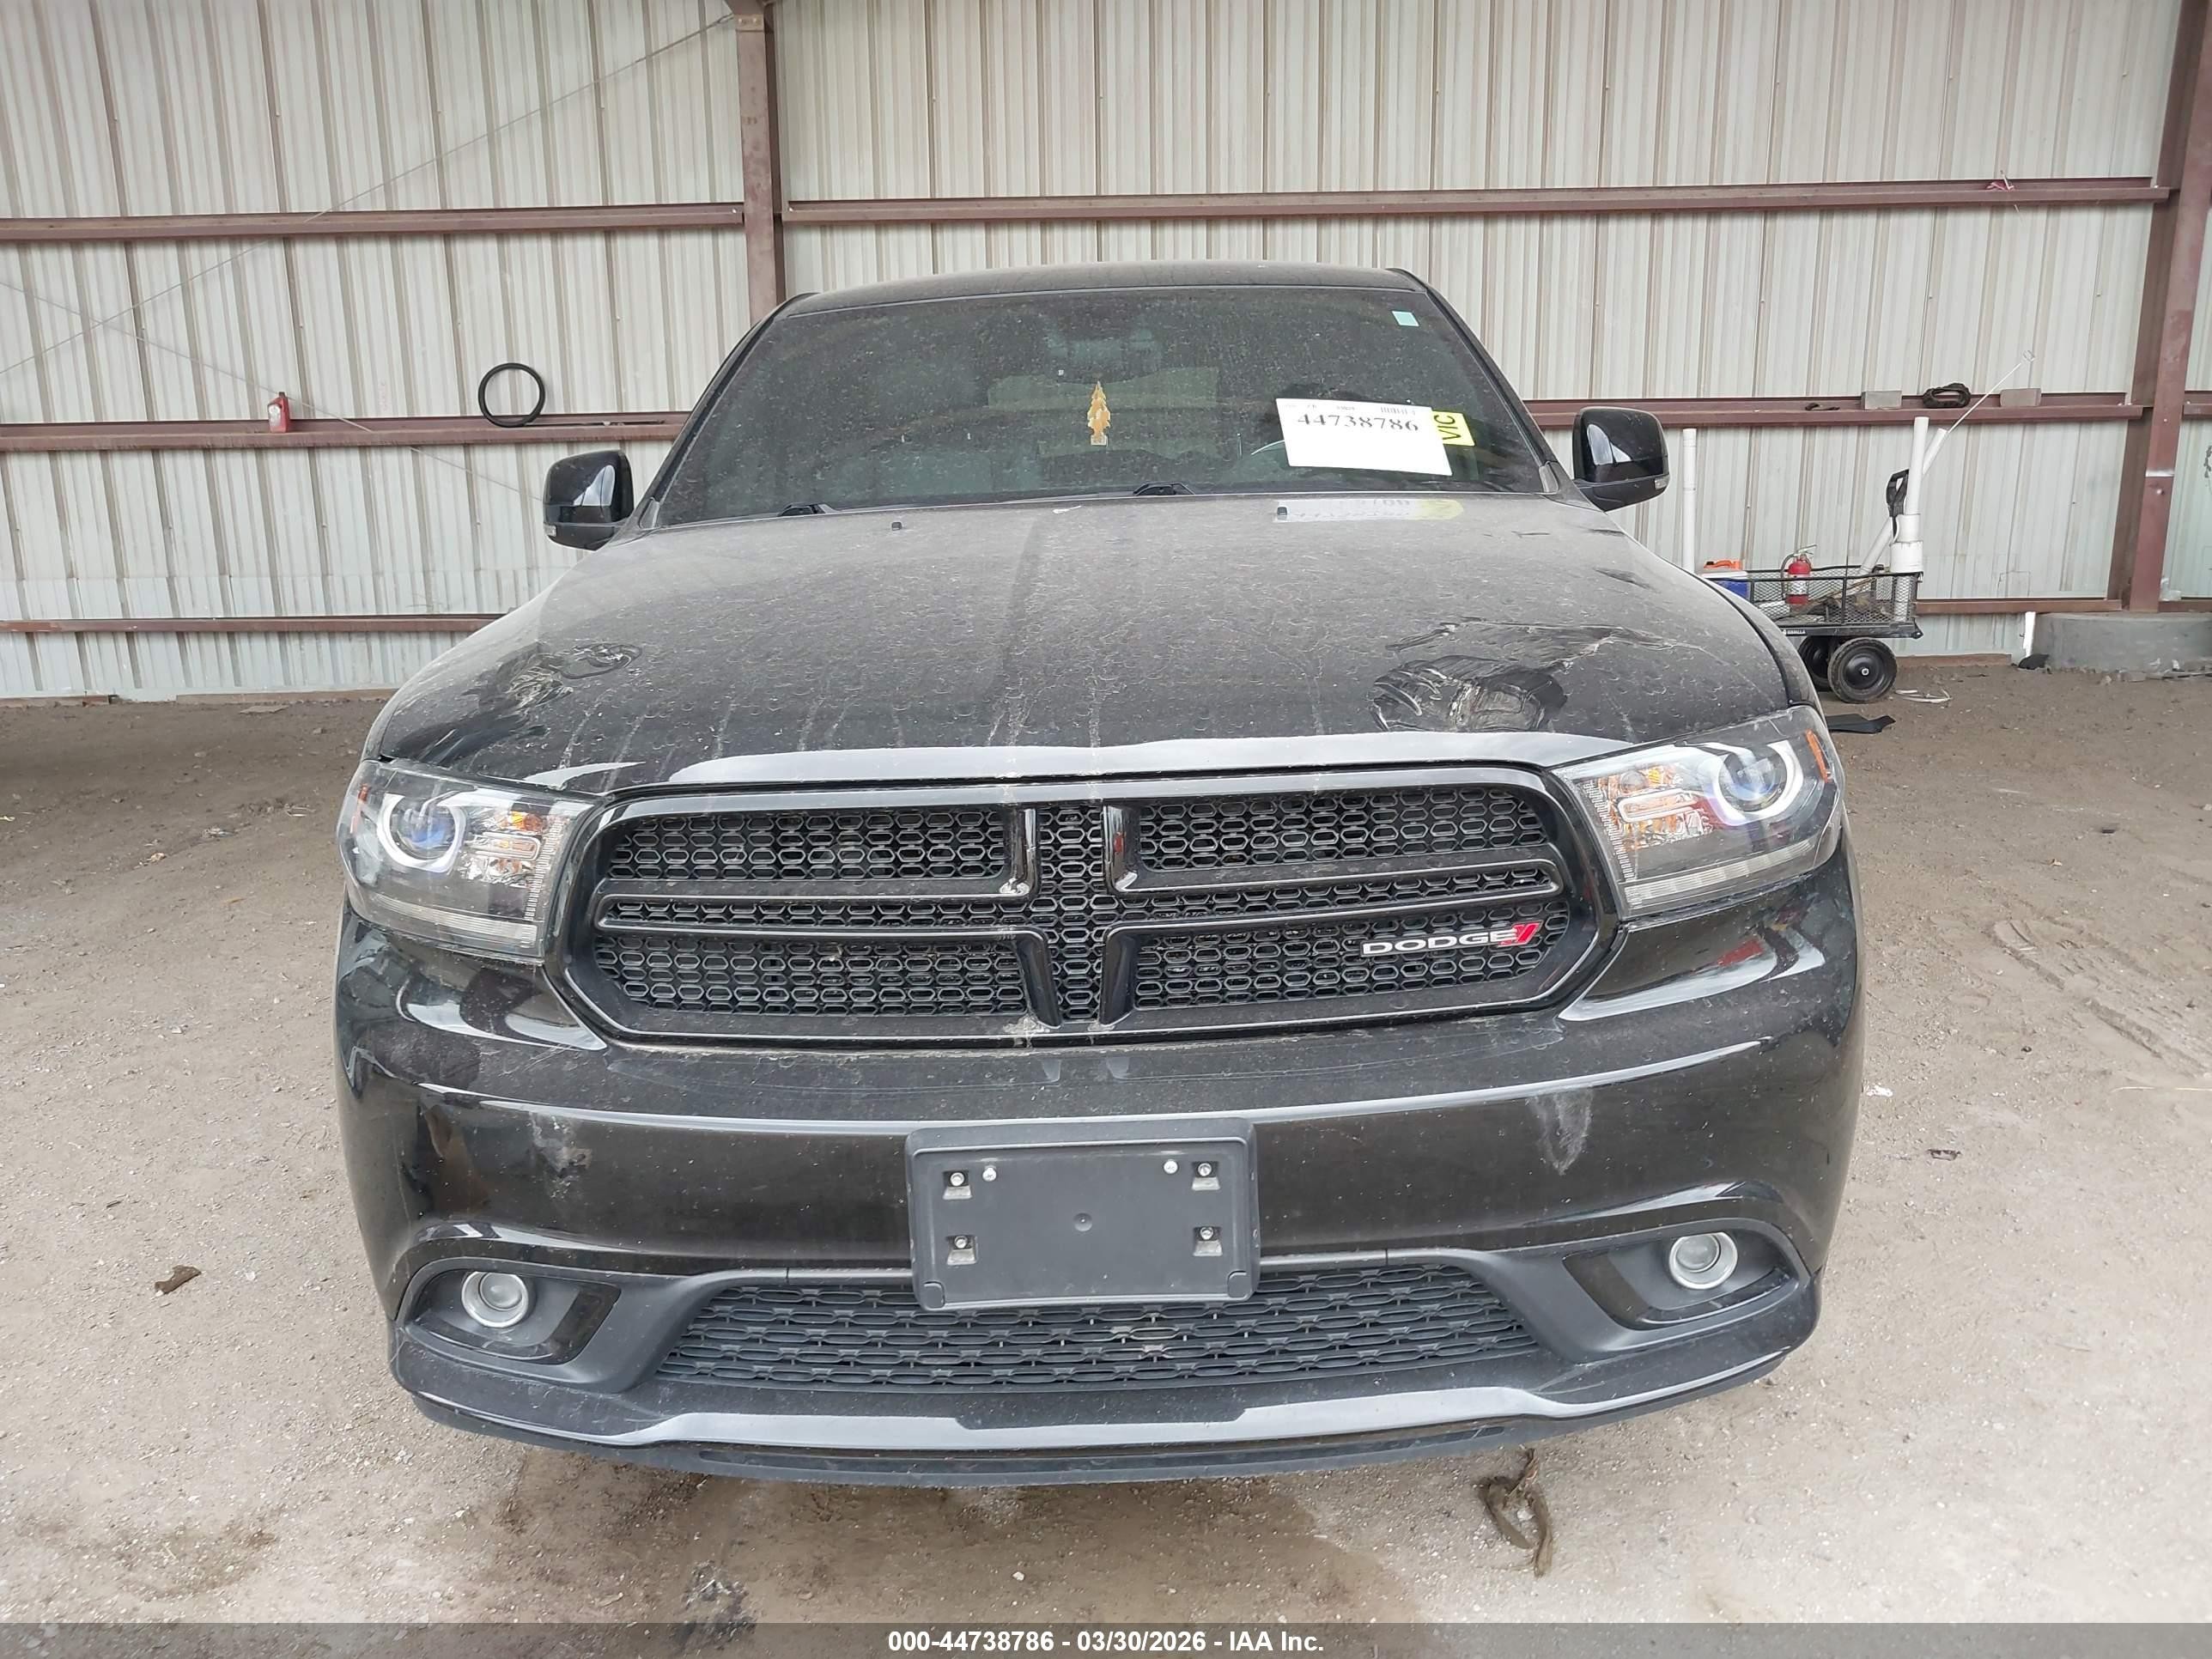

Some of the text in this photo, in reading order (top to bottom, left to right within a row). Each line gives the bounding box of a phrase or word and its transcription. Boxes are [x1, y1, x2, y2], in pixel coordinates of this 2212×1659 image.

[1297, 413, 1419, 431] 44738786
[1433, 415, 1462, 441] VIC
[1363, 927, 1517, 955] DODGE
